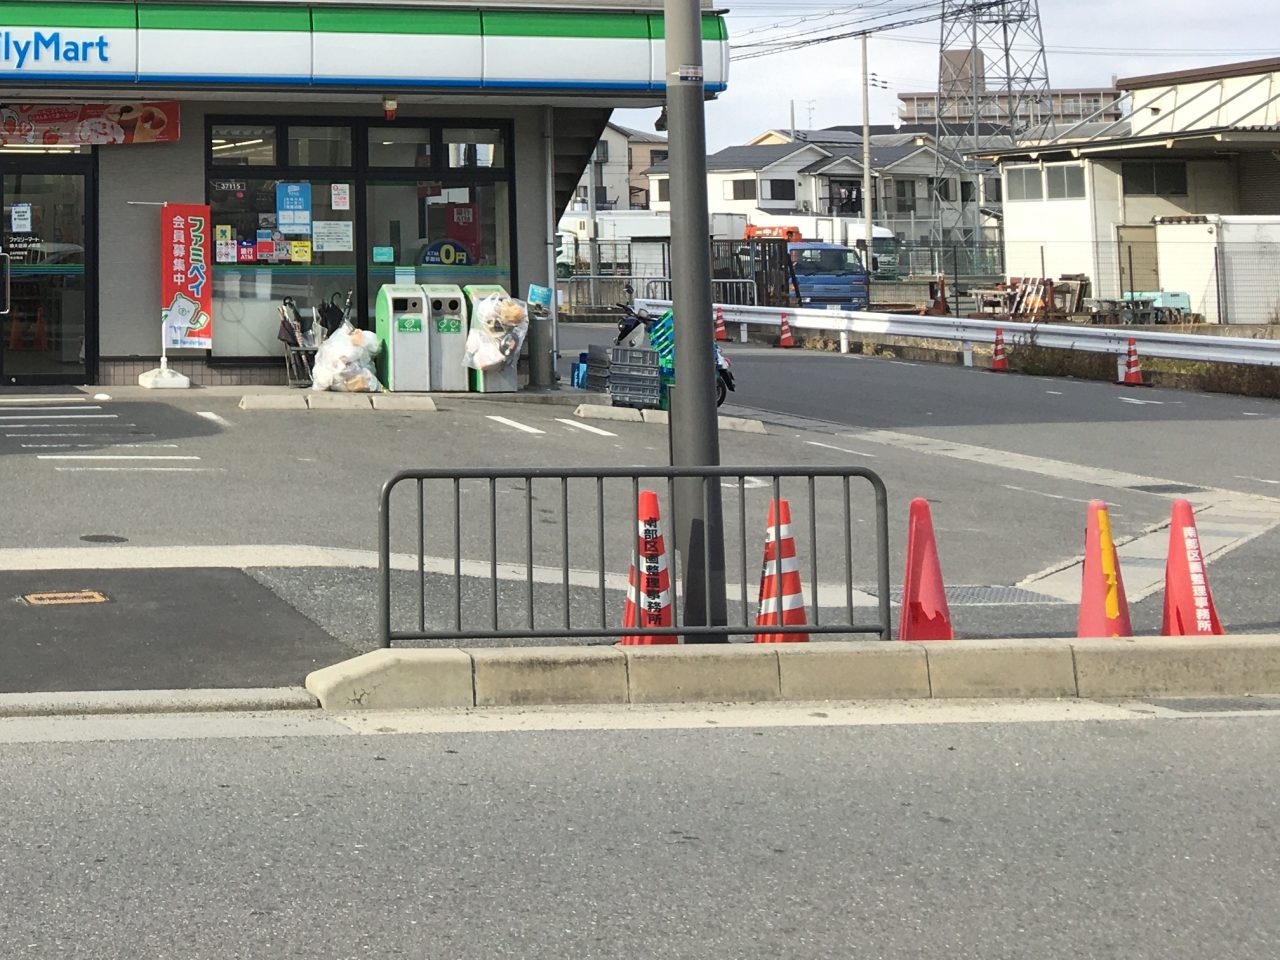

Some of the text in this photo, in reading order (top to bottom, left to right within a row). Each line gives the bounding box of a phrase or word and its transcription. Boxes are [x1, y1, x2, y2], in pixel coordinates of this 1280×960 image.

[173, 216, 186, 285] 会員募集中
[188, 217, 206, 297] ファミペイ
